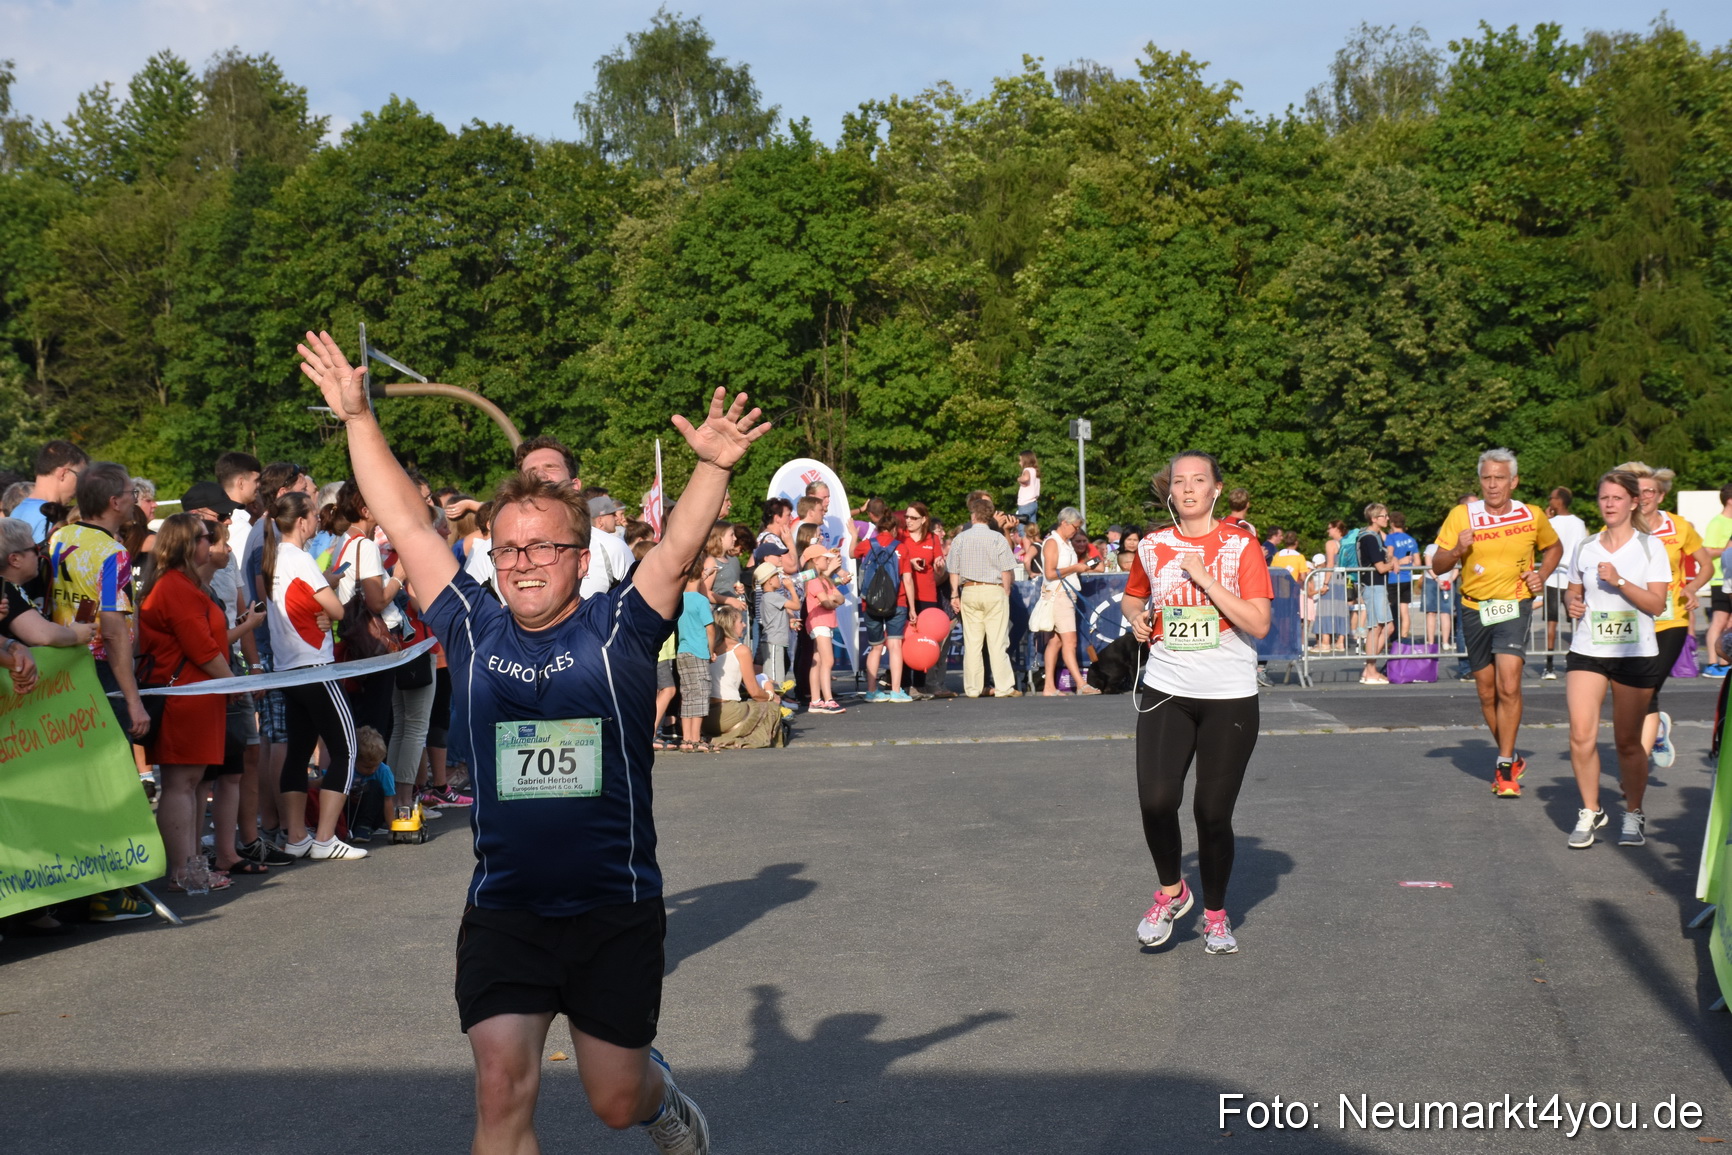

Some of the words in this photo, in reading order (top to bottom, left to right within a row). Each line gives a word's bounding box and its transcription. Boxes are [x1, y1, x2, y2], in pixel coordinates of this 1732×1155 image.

[1473, 531, 1501, 542] MAX
[1504, 524, 1536, 537] BÖGL
[1484, 603, 1514, 617] 1668
[1168, 622, 1209, 638] 2211
[1597, 622, 1633, 635] 1474
[517, 747, 577, 776] 705
[517, 777, 546, 786] Gabriel
[547, 776, 578, 784] Herbert
[0, 838, 150, 900] irmenlauf-oberpfalz.de
